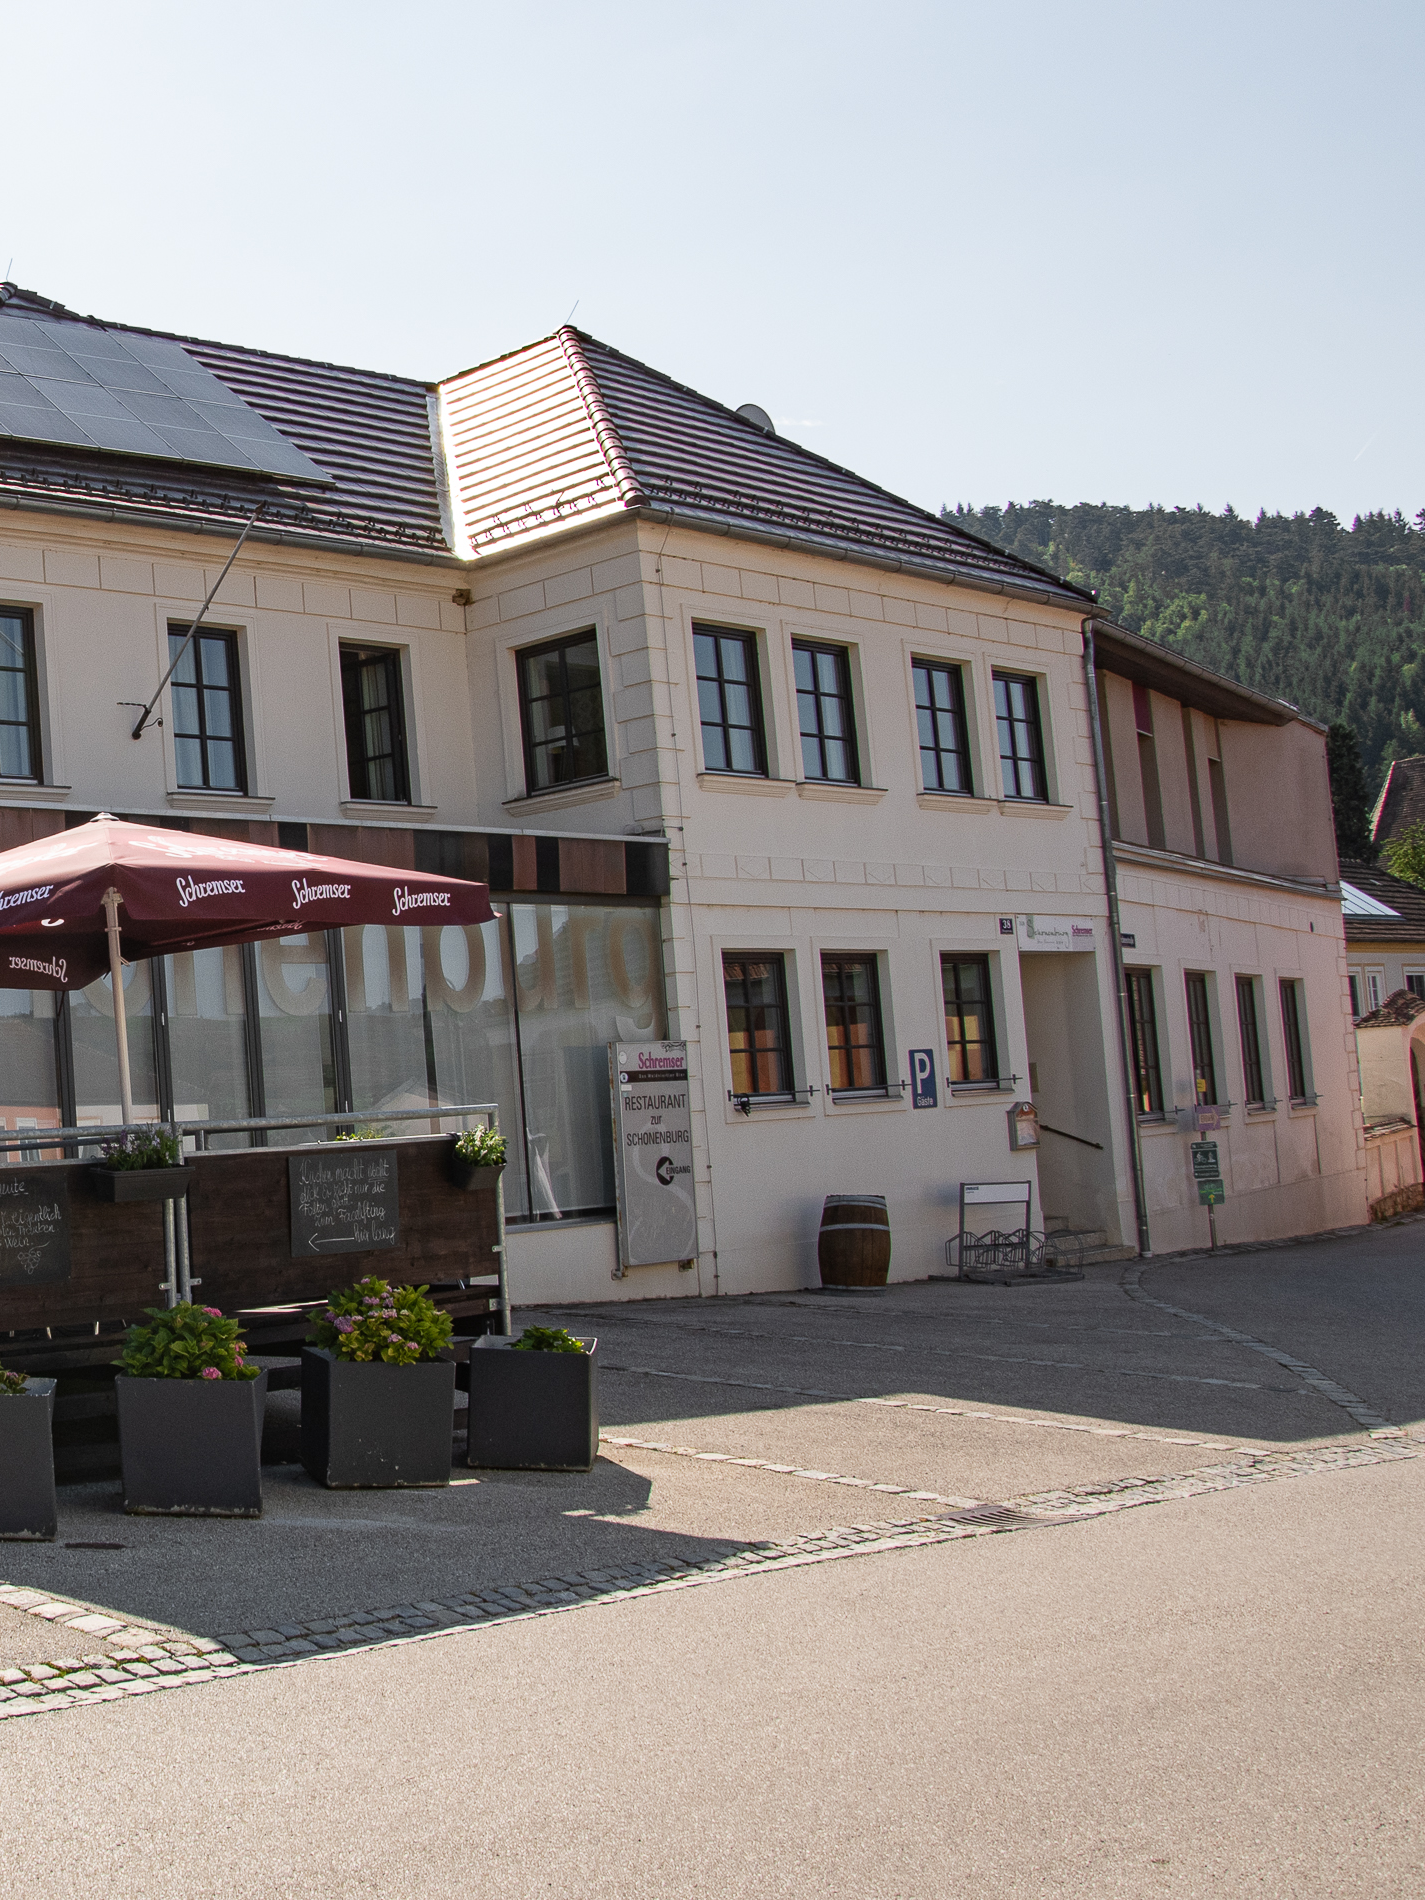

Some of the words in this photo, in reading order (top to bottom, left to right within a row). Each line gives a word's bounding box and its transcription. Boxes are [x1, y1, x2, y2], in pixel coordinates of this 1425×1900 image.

[176, 875, 245, 907] Schremser
[292, 878, 351, 909] Schremser
[392, 886, 451, 916] Schremser
[1002, 920, 1011, 929] 38
[638, 1051, 684, 1069] Schremser
[914, 1052, 930, 1094] P
[624, 1093, 686, 1111] RESTAURANT
[917, 1096, 933, 1106] Gäste
[650, 1115, 662, 1125] zur
[626, 1130, 689, 1146] SCHONENBURG
[336, 1158, 364, 1180] macht
[666, 1165, 691, 1175] EINGANG
[354, 1183, 369, 1194] nur
[371, 1182, 386, 1194] die
[353, 1222, 370, 1243] hier
[371, 1219, 395, 1245] lang
